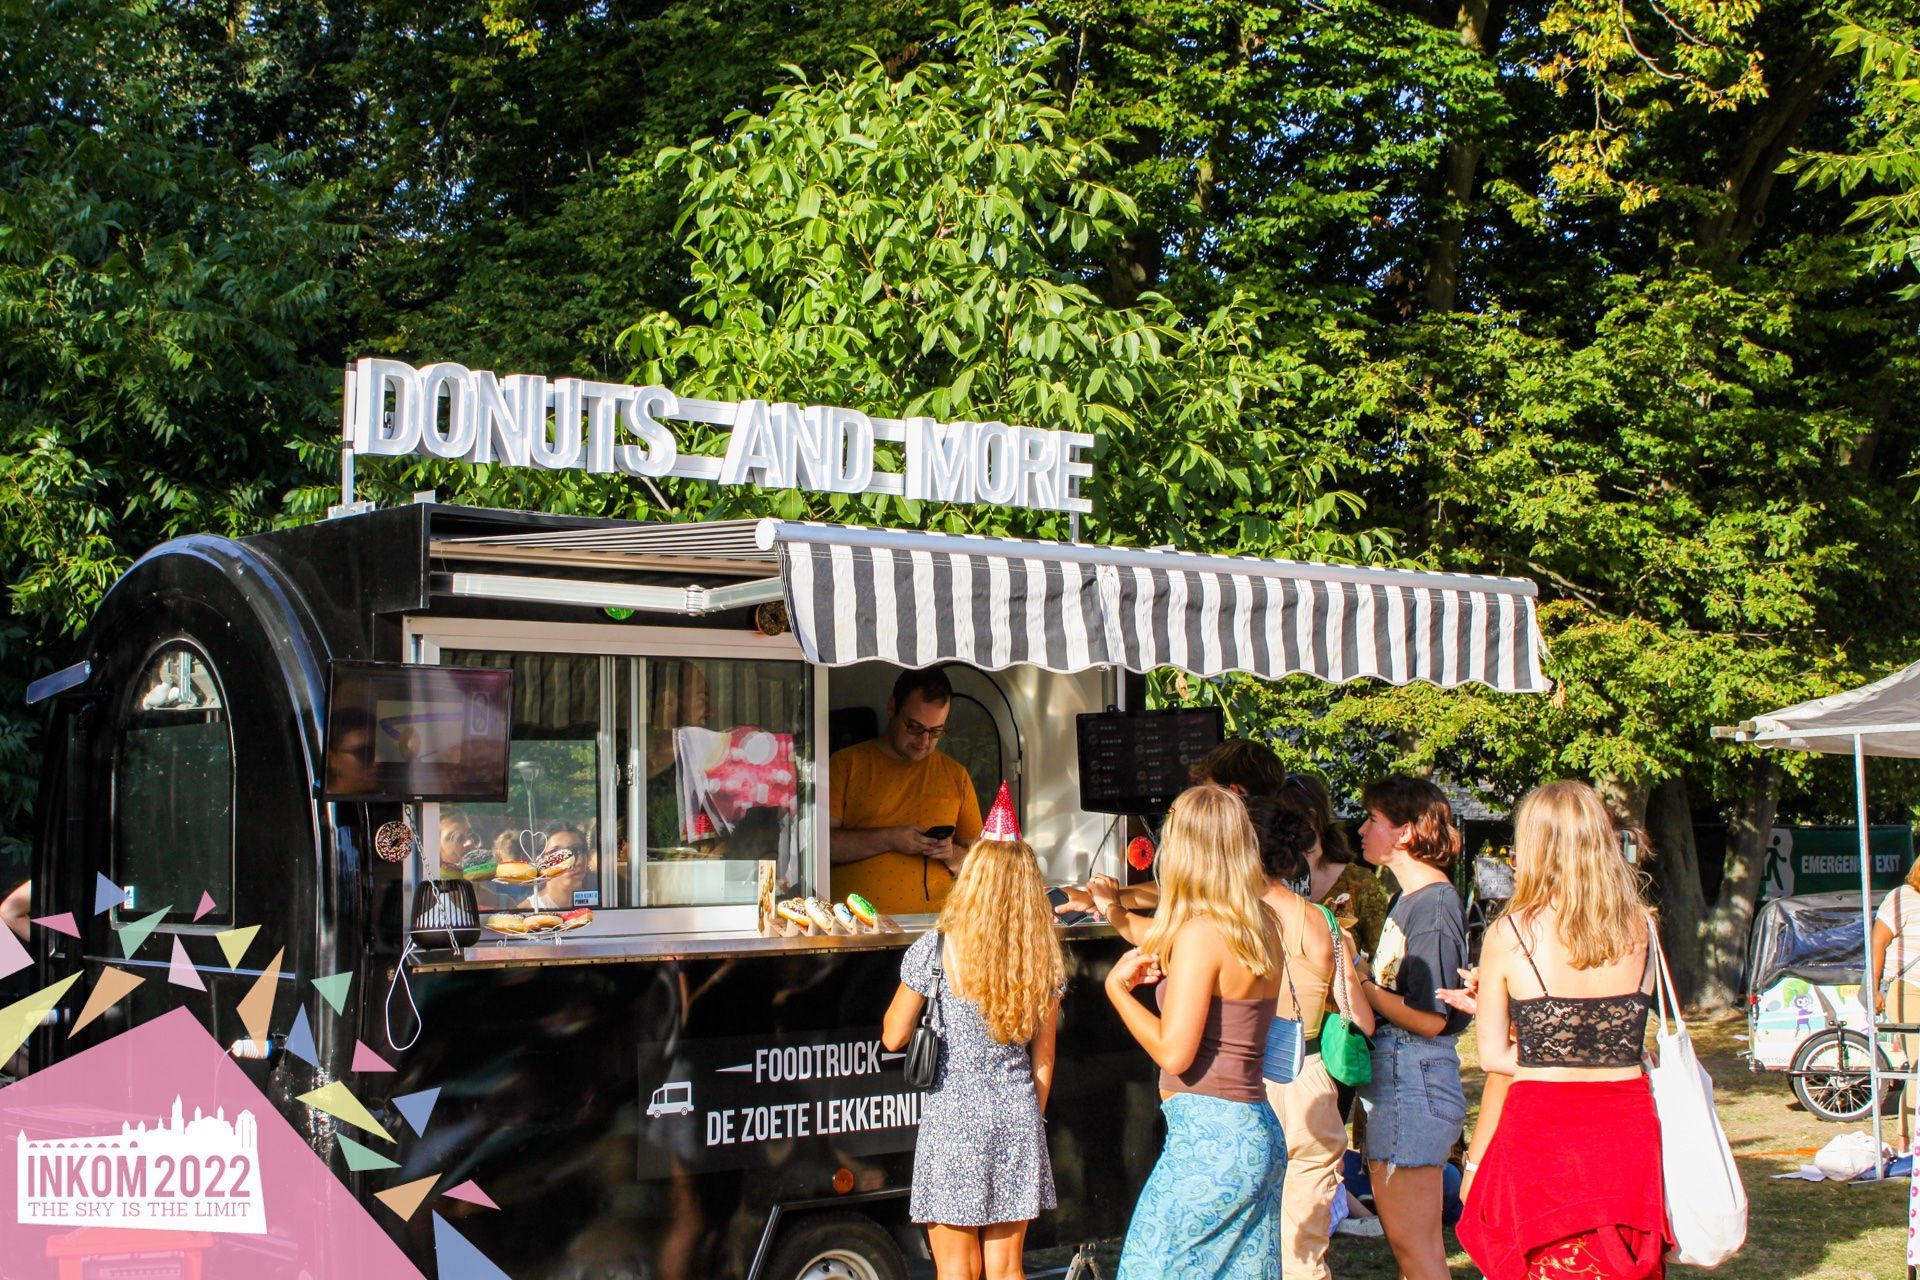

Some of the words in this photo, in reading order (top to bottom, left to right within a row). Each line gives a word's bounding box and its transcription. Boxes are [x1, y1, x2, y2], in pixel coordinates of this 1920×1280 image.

[354, 358, 679, 478] DONUTS
[718, 399, 875, 494] AND
[905, 416, 1094, 514] MORE
[1801, 855, 1872, 873] EMERGEN
[1876, 855, 1901, 873] EXIT
[755, 1040, 881, 1084] FOODTRUCK
[706, 1109, 735, 1146] DE
[741, 1103, 810, 1143] ZOETE
